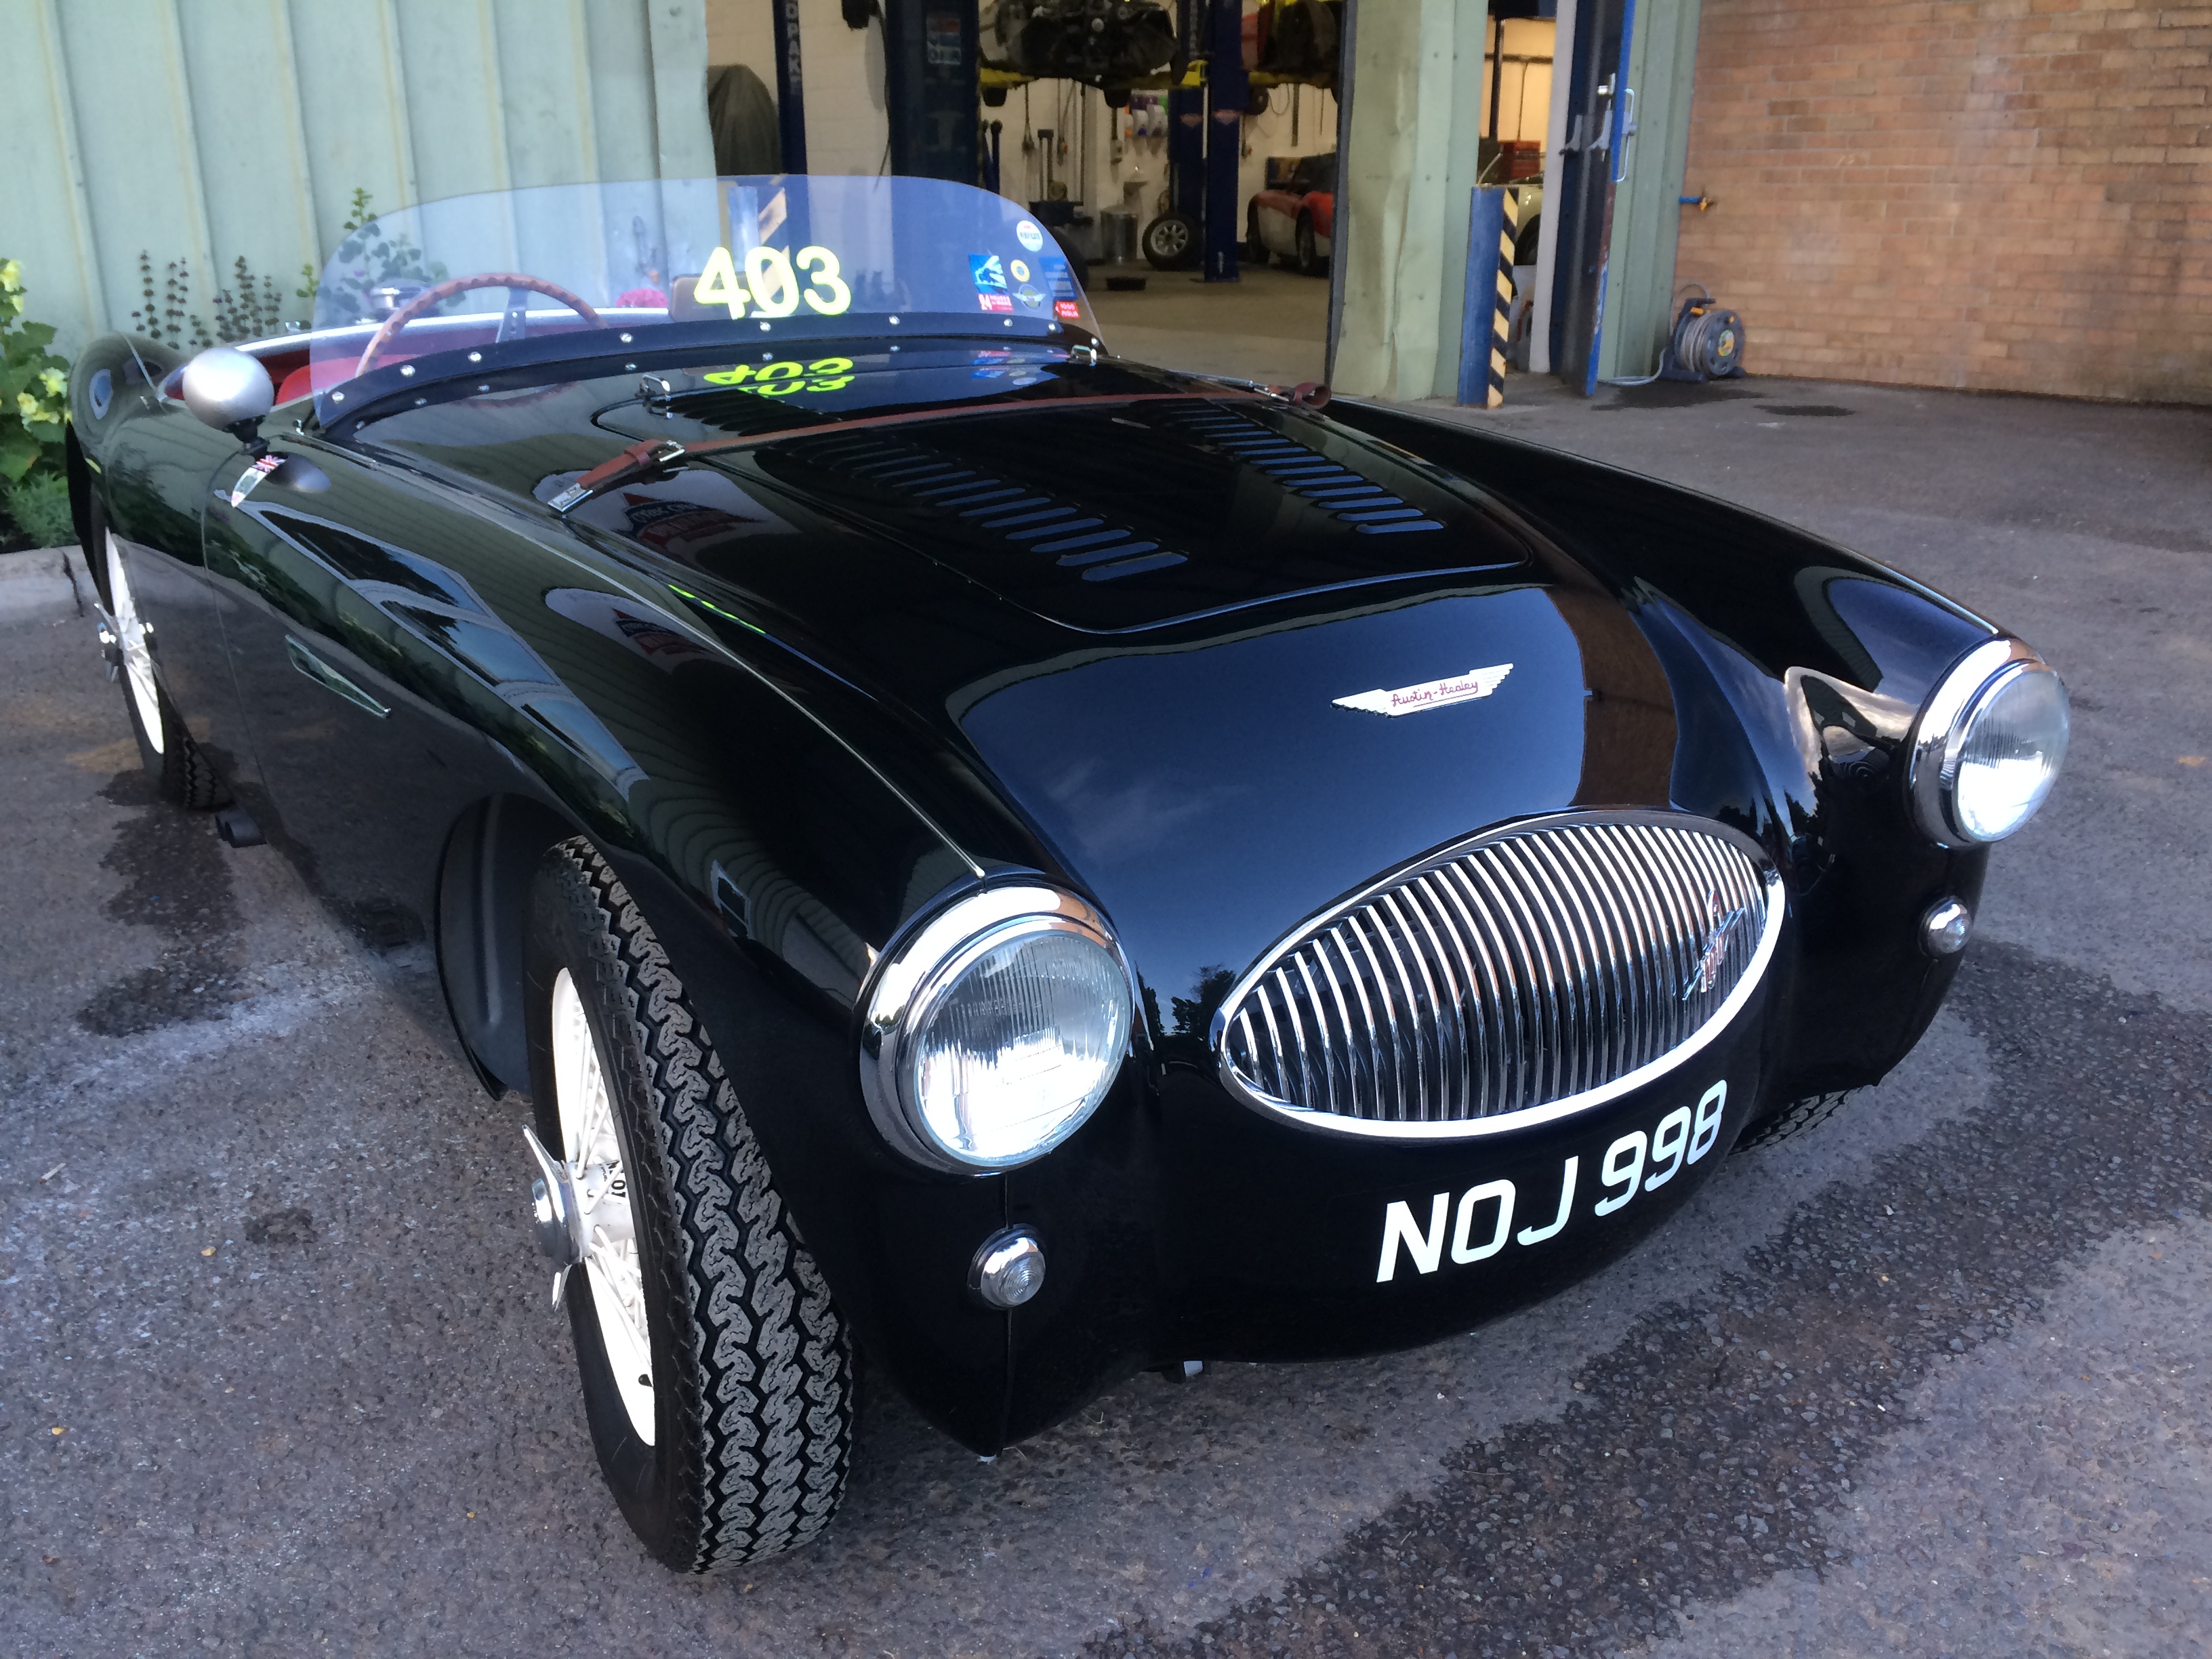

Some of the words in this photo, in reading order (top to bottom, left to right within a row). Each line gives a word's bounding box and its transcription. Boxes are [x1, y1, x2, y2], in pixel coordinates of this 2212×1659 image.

[694, 246, 851, 321] 403
[1391, 680, 1479, 708] Austin-Healey
[1376, 1155, 1579, 1283] NOJ
[1595, 1080, 1727, 1216] 998
